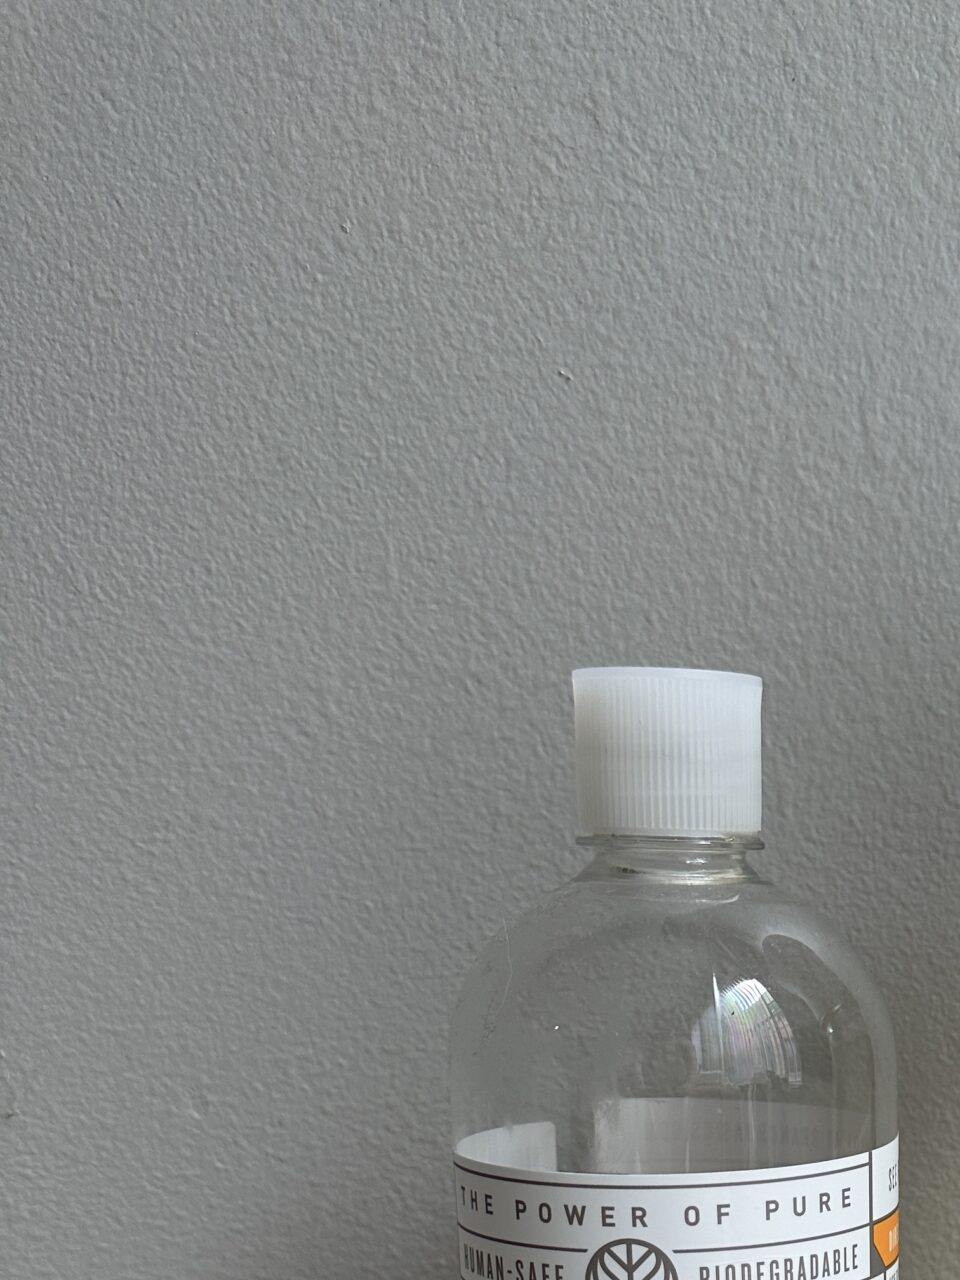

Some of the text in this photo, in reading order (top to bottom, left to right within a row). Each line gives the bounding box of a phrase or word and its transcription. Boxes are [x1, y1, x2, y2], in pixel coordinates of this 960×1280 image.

[461, 1186, 851, 1228] THE POWER OF PURE
